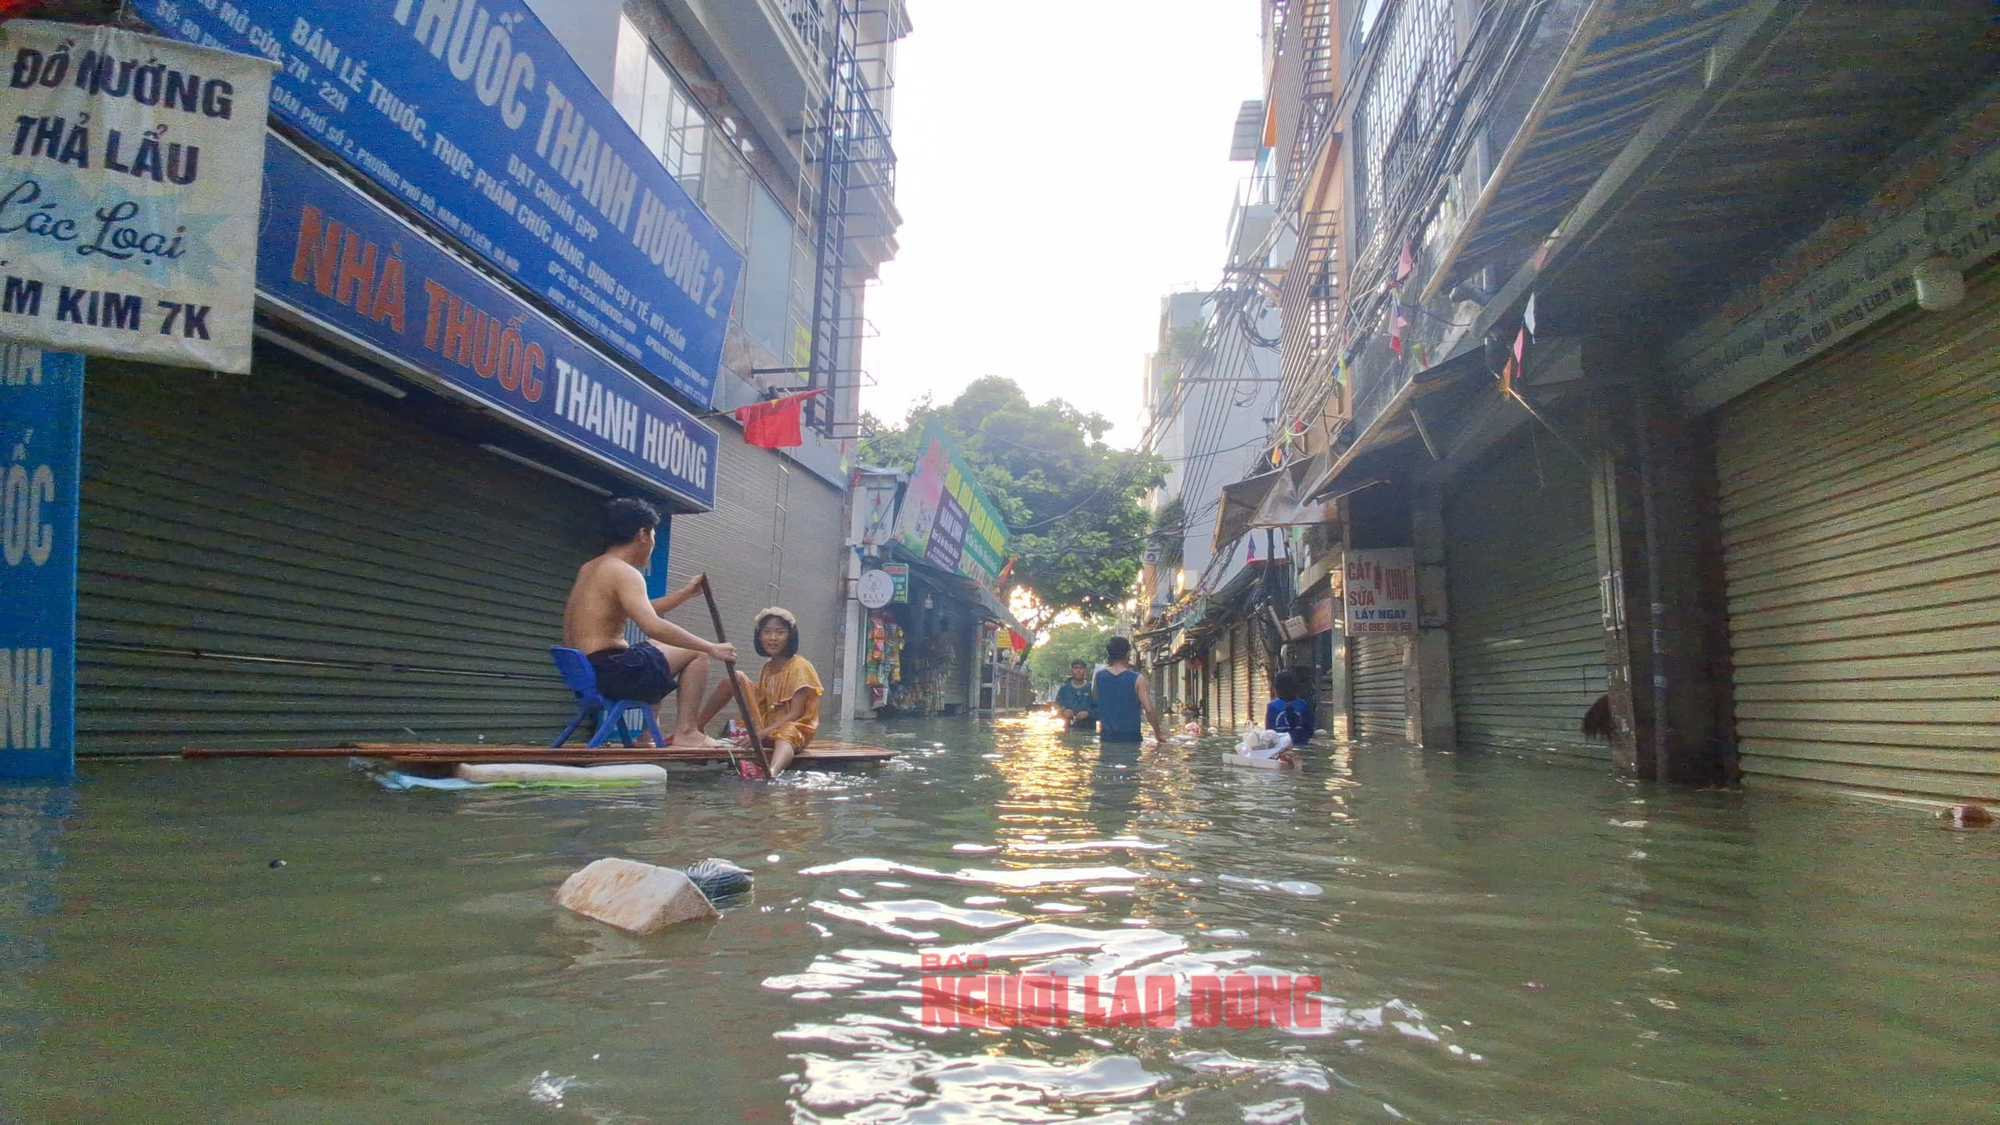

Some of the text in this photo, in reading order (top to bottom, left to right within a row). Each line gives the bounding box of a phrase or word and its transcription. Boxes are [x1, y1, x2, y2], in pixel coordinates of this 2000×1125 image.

[9, 38, 234, 121] ĐỒ NƯỚNG
[318, 81, 350, 113] 22H
[11, 112, 200, 186] THẢ LẨU
[290, 16, 341, 72] BÁN
[338, 56, 368, 94] LẺ
[367, 78, 429, 149] THUỐC,
[433, 131, 475, 180] THỰC
[474, 168, 518, 216] PHẨM
[516, 203, 552, 244] CHỨC
[551, 229, 586, 275] NĂNG,
[586, 260, 617, 296] DỤNG
[615, 283, 631, 309] CỤ
[629, 294, 639, 312] Y
[0, 179, 187, 265] Các Loại
[534, 178, 576, 227] CHUẨN
[574, 211, 599, 243] GPP
[536, 80, 640, 233] THANH
[704, 266, 724, 320] 2
[56, 285, 143, 332] KIM
[157, 299, 212, 341] 7K
[291, 203, 405, 334] NHÀ
[423, 277, 546, 403] THUỐC
[554, 356, 639, 454] THANH
[642, 411, 708, 491] HƯỜNG
[1379, 609, 1407, 620] NGAY
